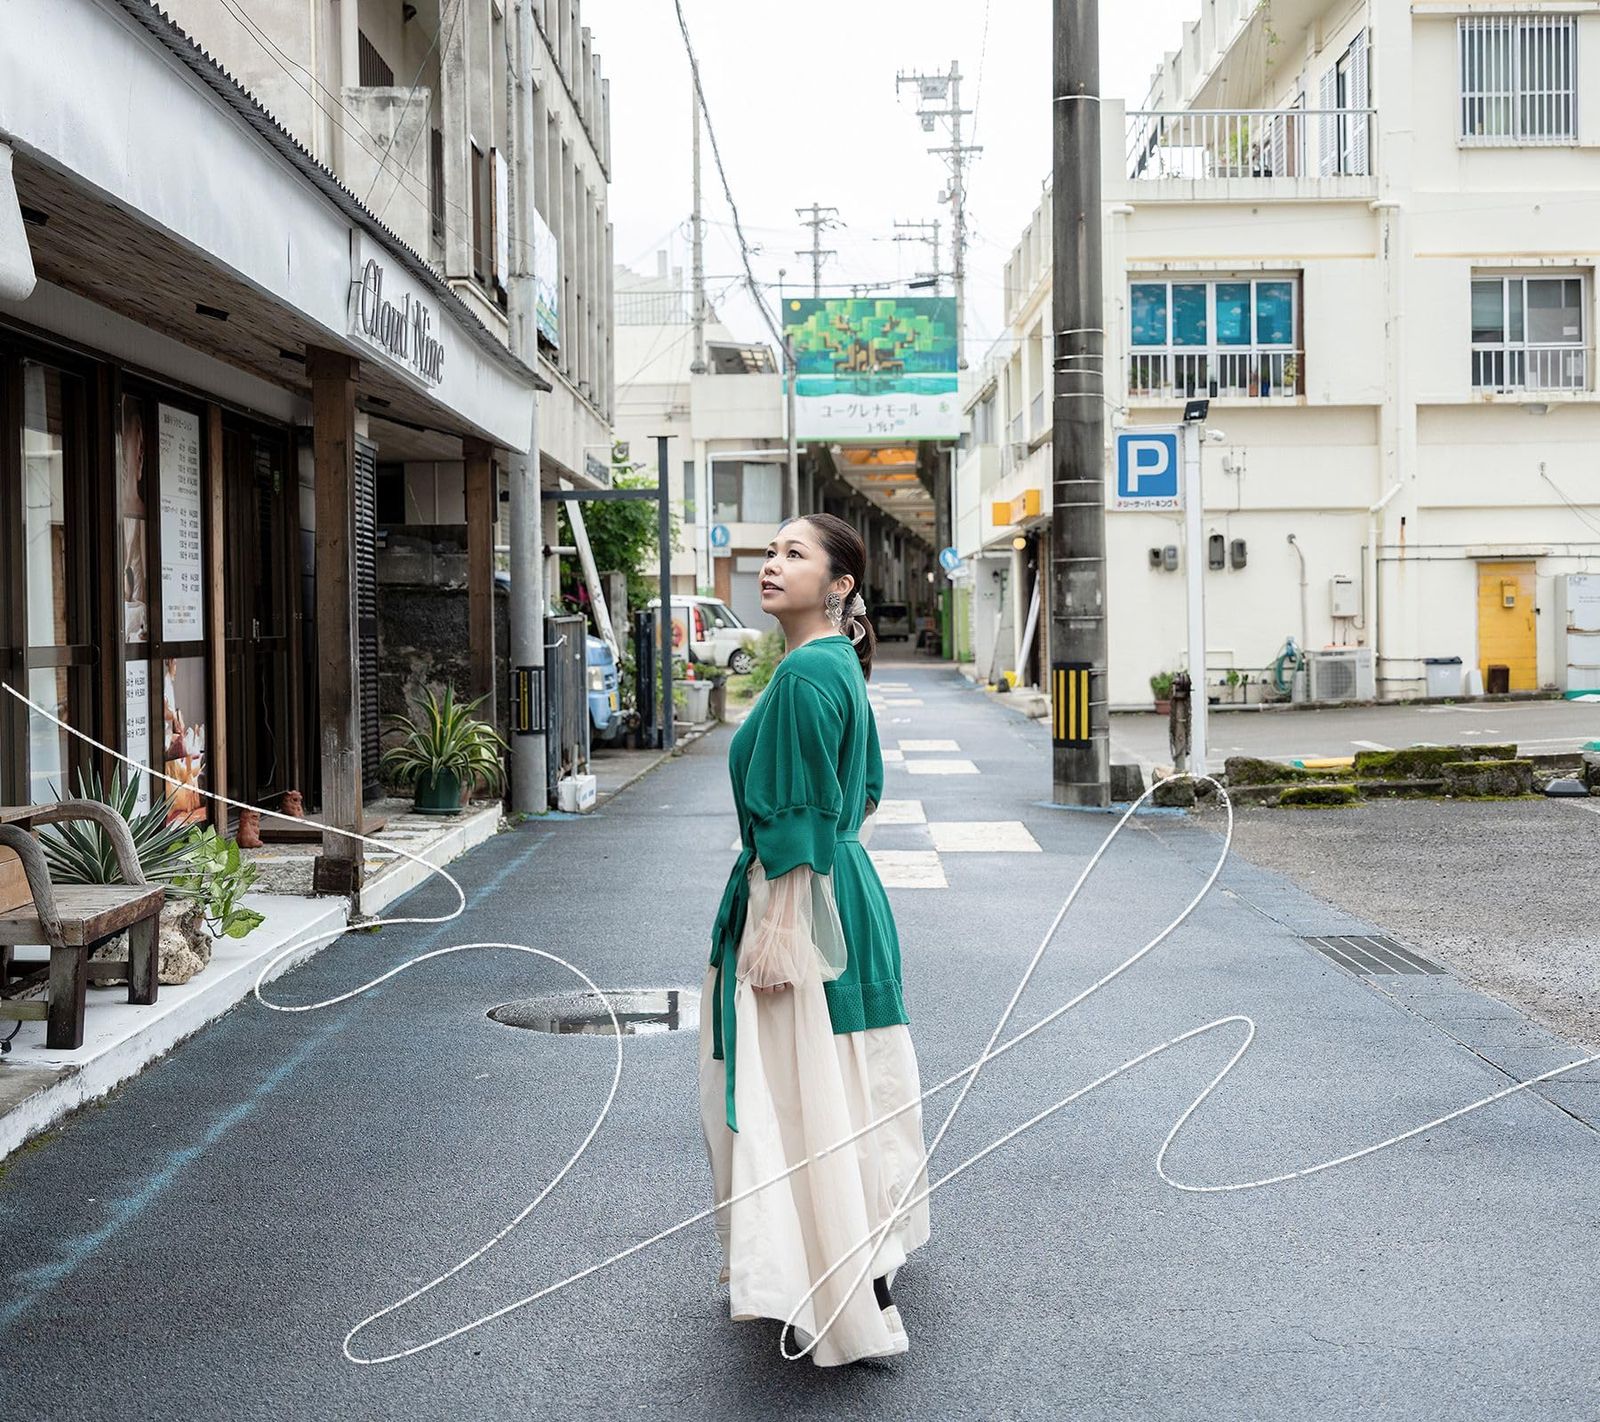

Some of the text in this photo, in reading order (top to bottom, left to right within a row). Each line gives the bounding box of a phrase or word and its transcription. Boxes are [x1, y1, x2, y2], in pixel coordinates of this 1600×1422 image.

[362, 259, 444, 384] Cloud Nine
[821, 403, 920, 418] ユーグレナモール
[1127, 440, 1169, 492] P
